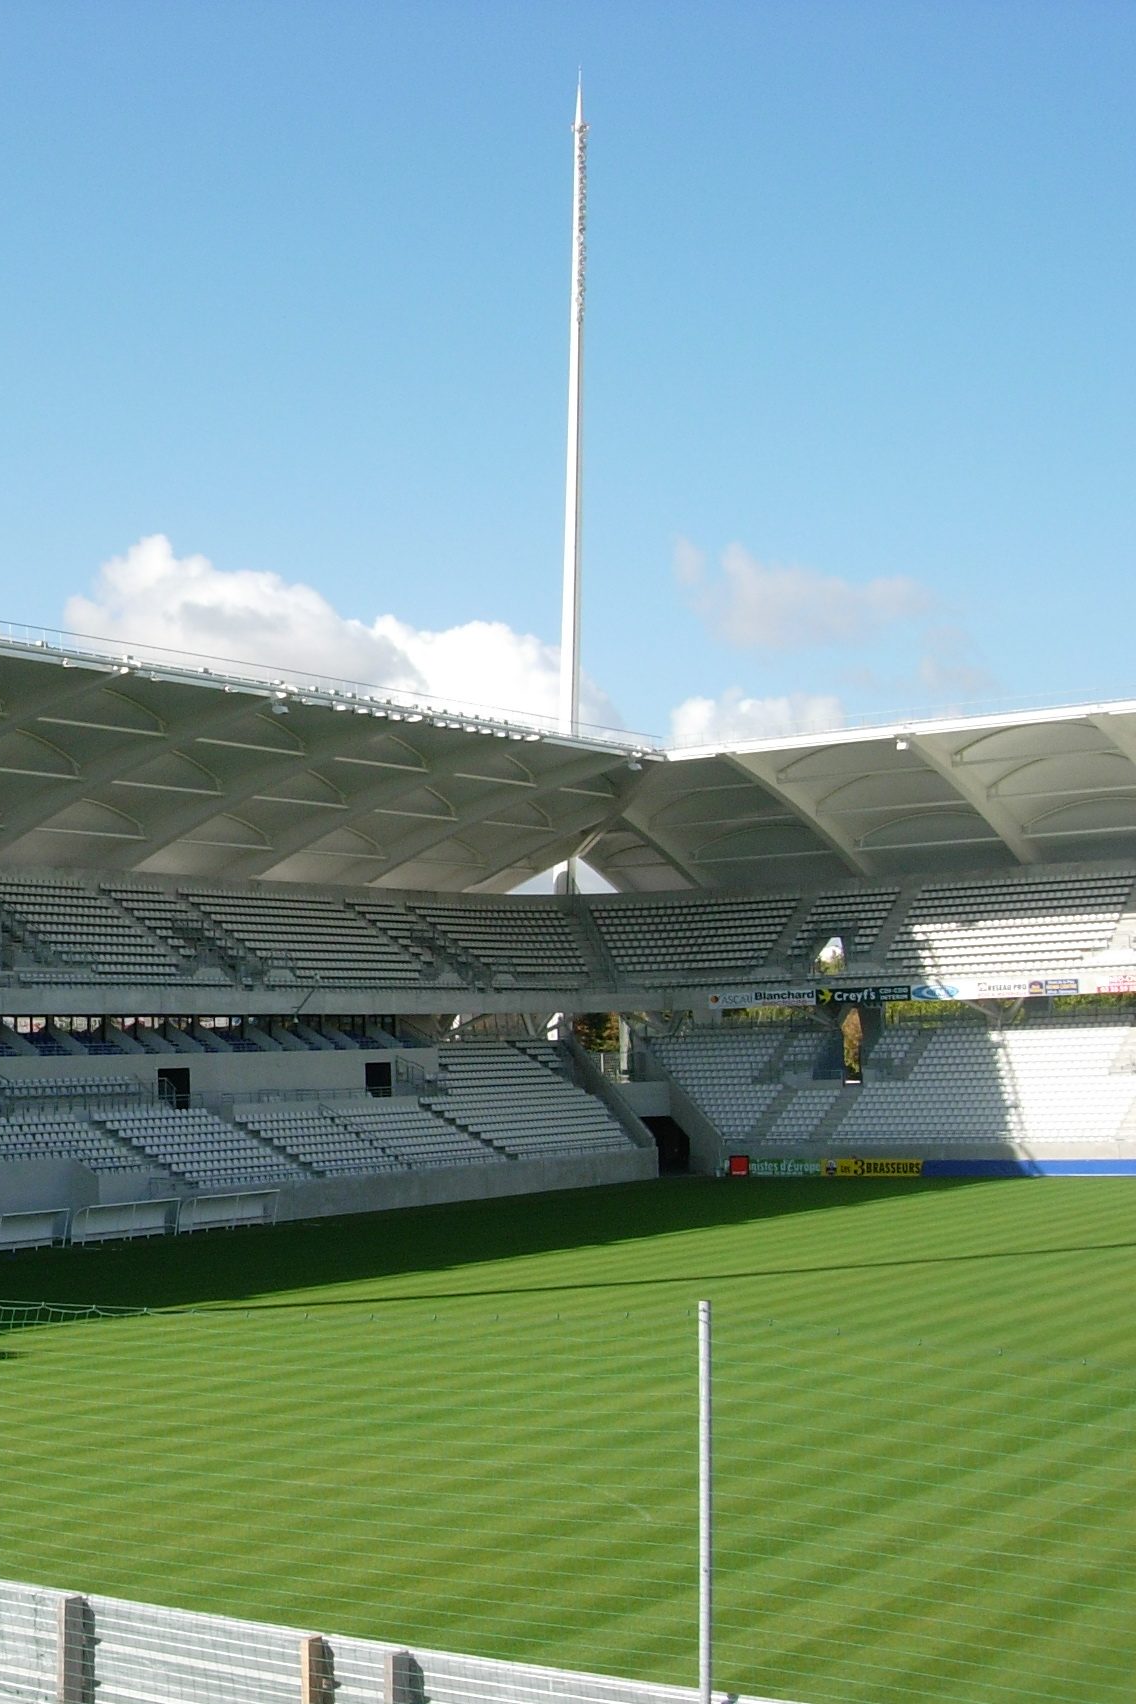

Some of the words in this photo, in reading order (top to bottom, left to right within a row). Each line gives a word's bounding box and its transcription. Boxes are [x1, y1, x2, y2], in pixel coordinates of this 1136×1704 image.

[754, 990, 815, 1001] Blanchard
[834, 988, 876, 1002] Creyf's
[854, 1159, 864, 1176] 3
[866, 1160, 921, 1175] BRASSEURS
